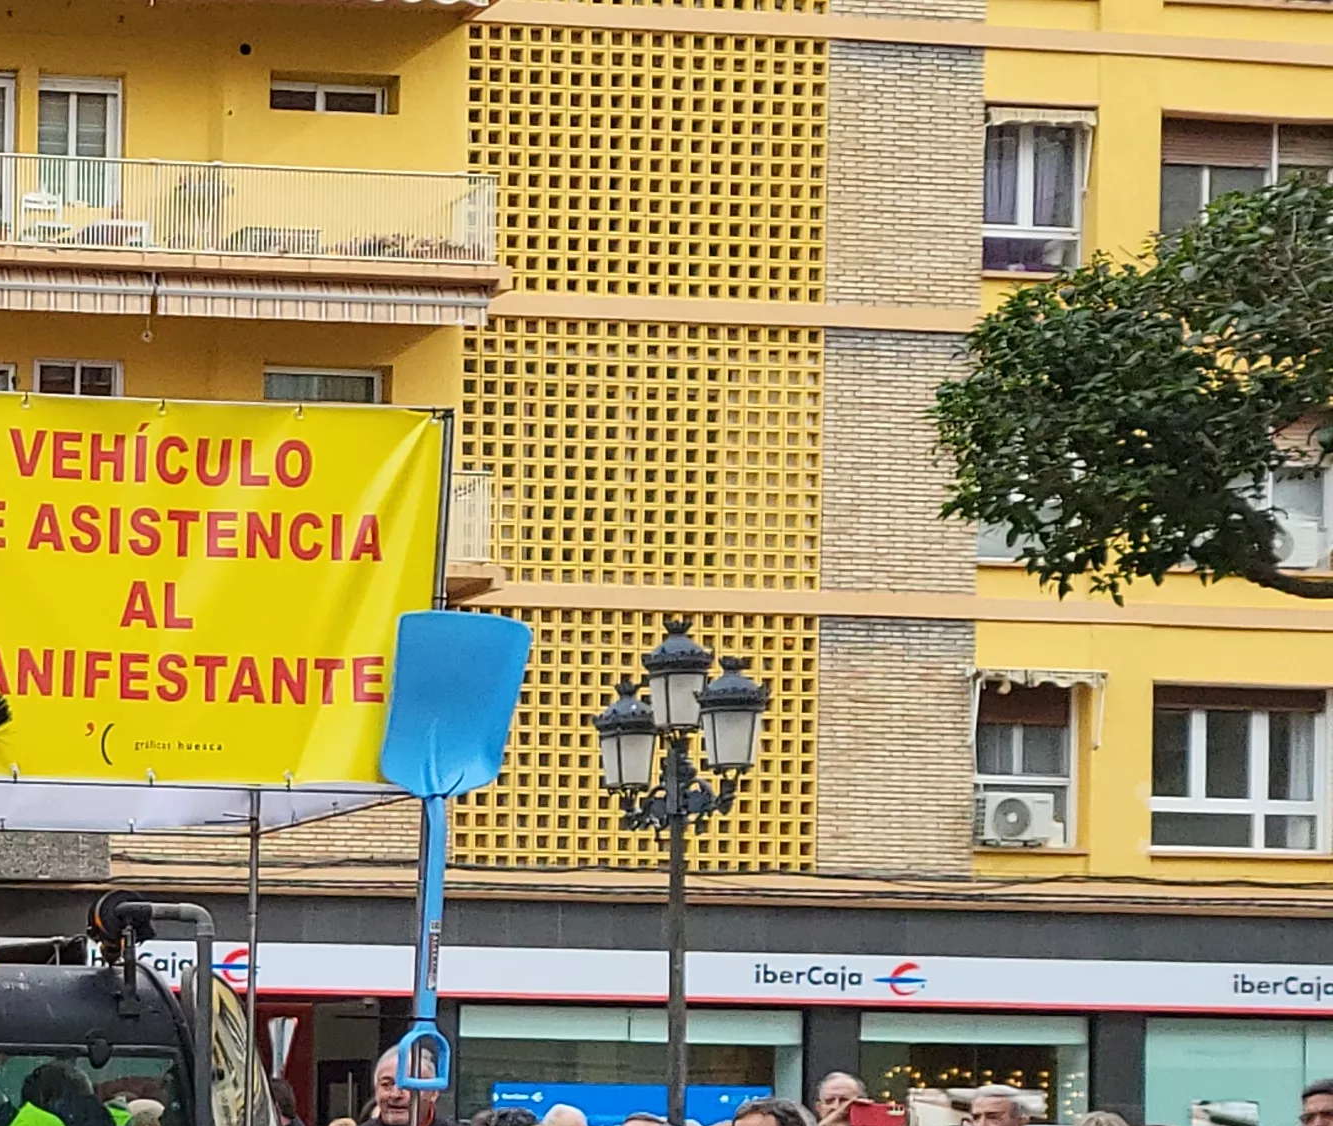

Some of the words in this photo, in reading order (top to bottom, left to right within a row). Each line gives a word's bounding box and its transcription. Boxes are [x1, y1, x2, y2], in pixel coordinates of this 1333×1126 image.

[10, 424, 313, 488] VEHÍCULO
[27, 504, 382, 562] ASISTENCIA
[120, 581, 194, 630] AL
[754, 963, 863, 991] iberCaja
